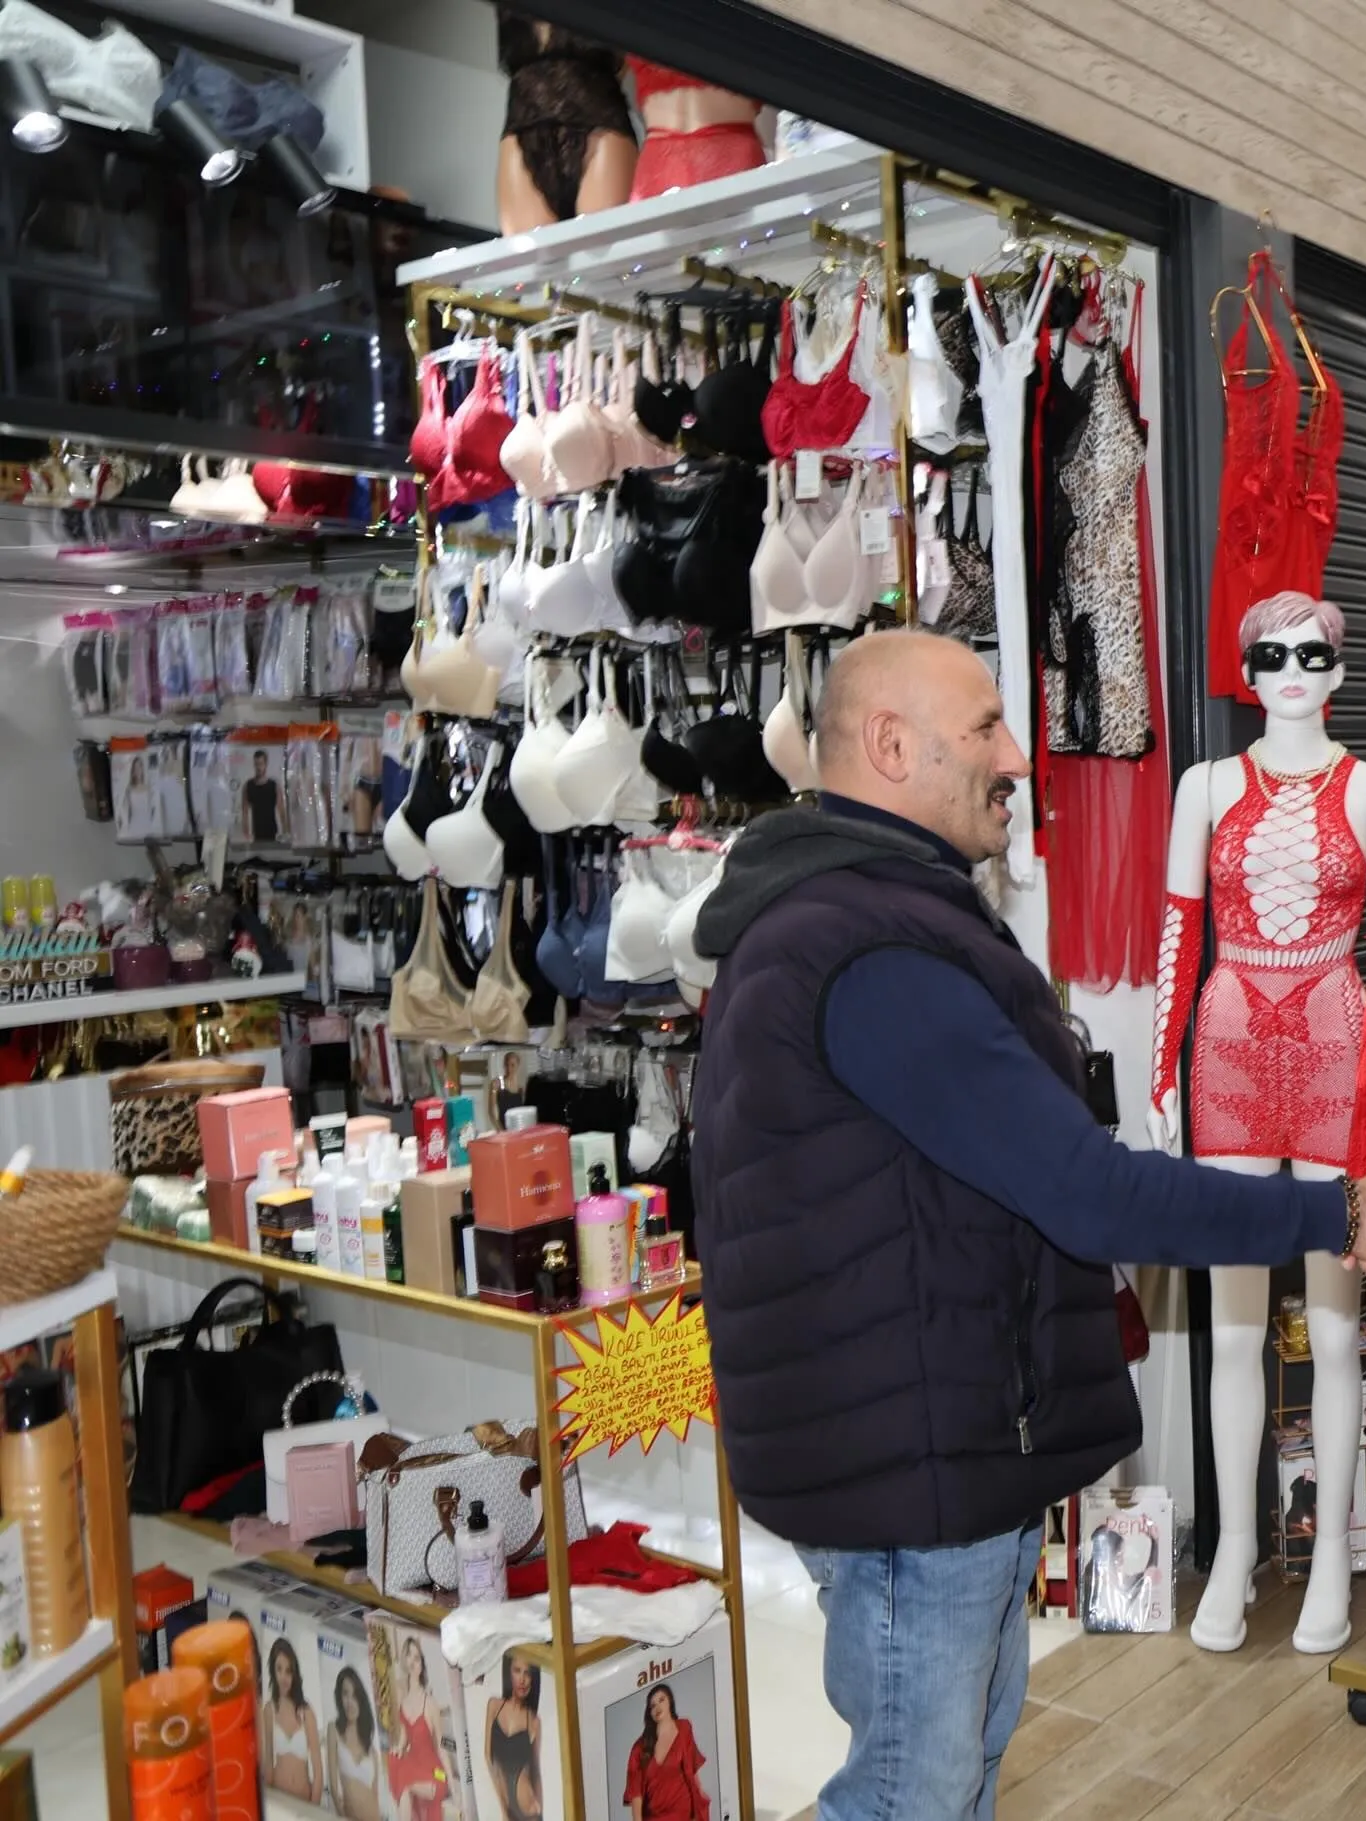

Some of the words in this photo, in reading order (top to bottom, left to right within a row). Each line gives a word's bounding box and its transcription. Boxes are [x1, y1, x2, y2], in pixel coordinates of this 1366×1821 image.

[0, 961, 34, 982] OM
[41, 958, 98, 978] FORD
[636, 1658, 673, 1687] ahu
